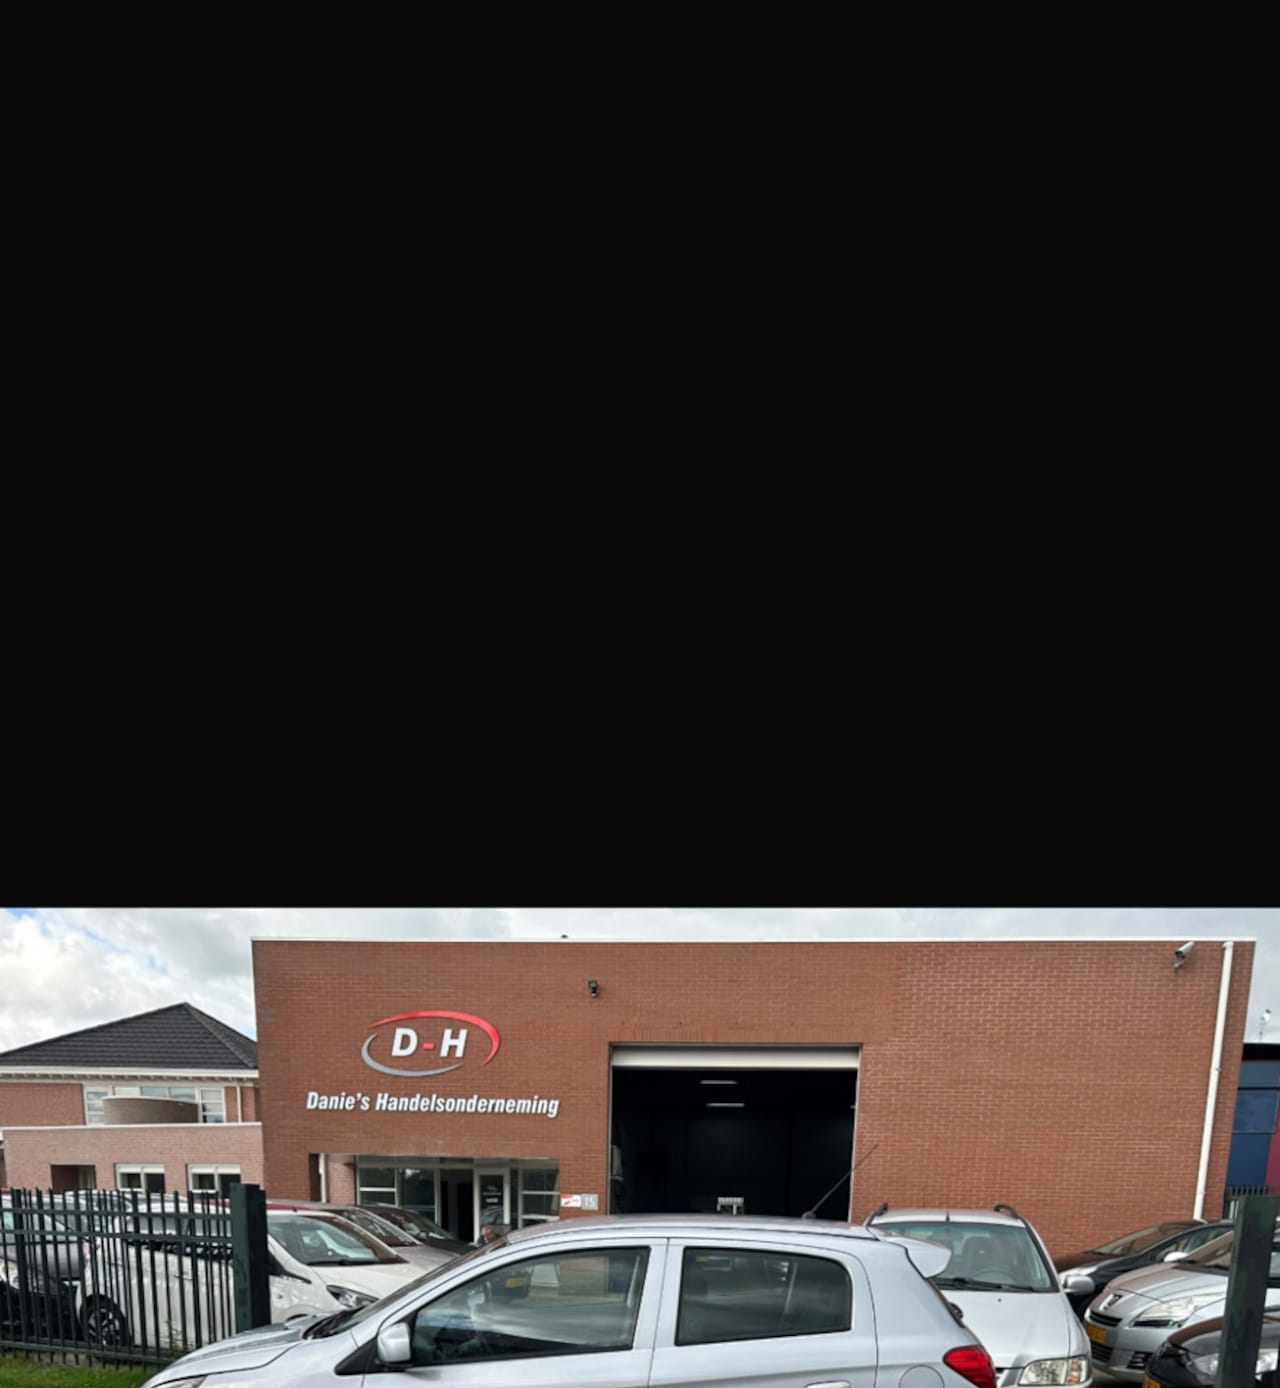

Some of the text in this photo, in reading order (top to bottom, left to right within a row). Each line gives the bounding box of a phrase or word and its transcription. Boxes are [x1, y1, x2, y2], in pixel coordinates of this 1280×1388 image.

[391, 1027, 468, 1057] D-H
[306, 1091, 560, 1118] Danie's Handelsonderneming
